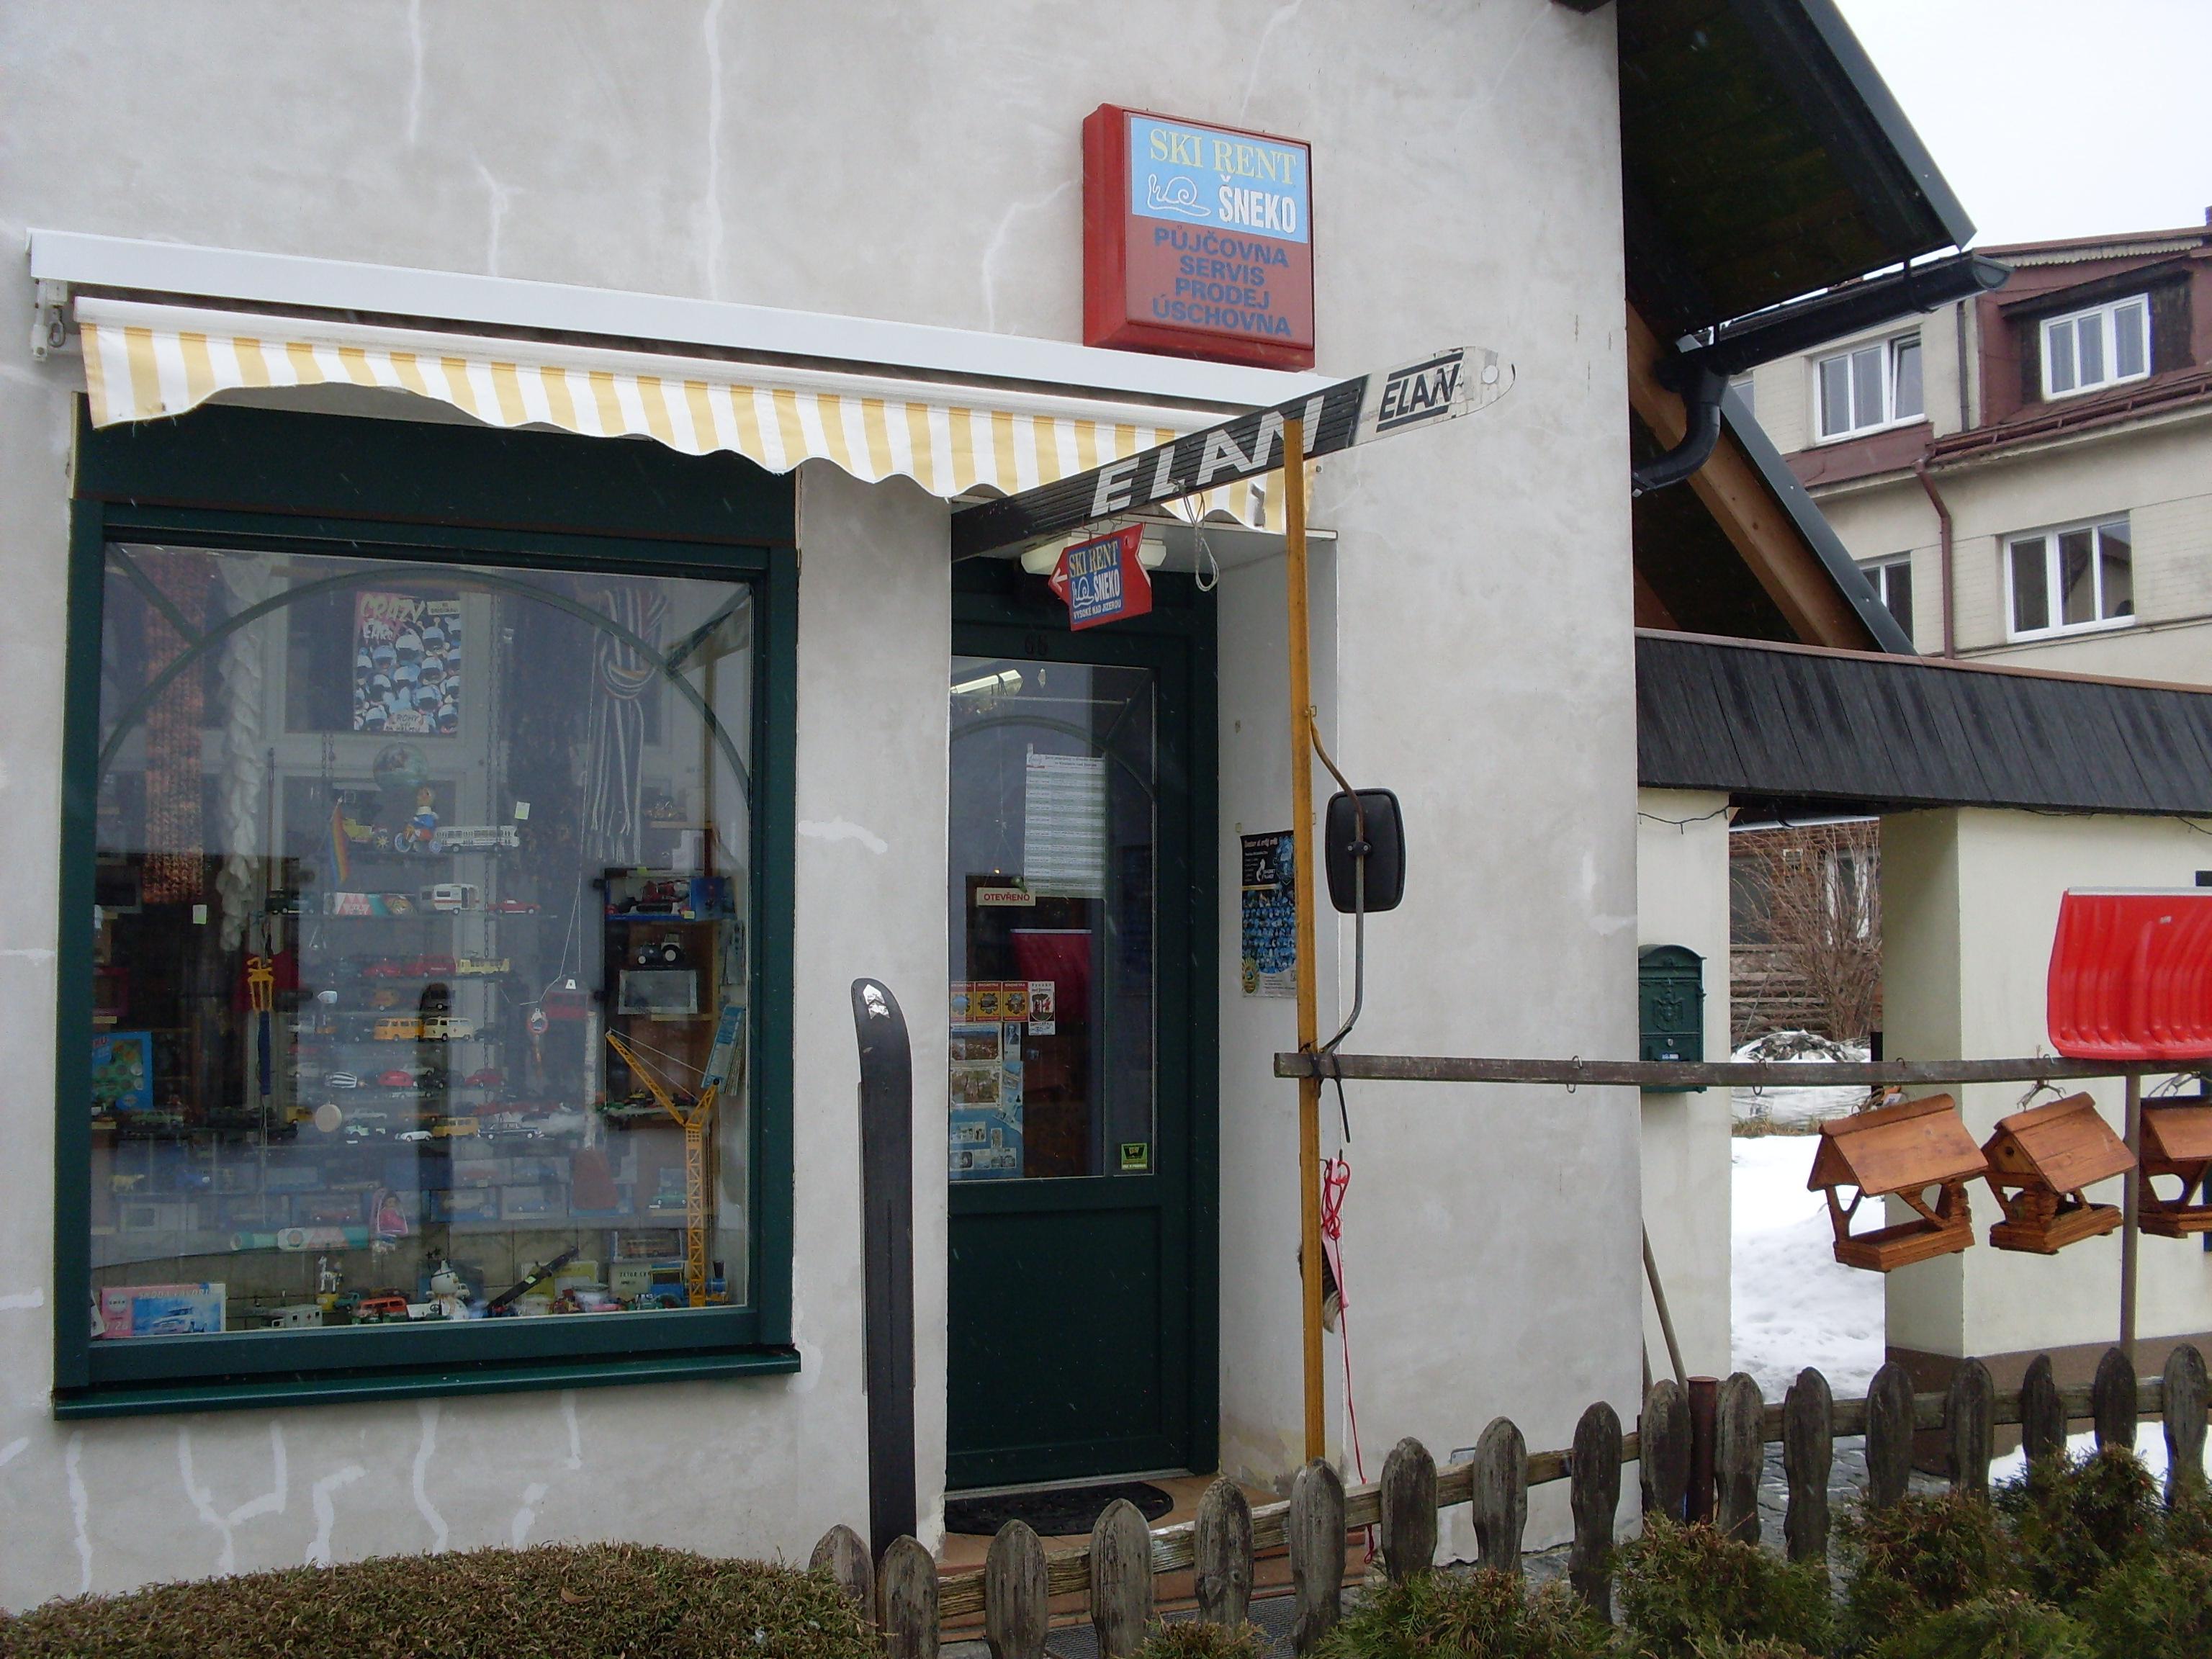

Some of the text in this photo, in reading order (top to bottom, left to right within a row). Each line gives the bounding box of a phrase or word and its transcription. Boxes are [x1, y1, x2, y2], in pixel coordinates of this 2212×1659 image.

[1150, 128, 1296, 184] SKI RENT
[1218, 174, 1296, 233] ŠNEKO
[1154, 224, 1290, 268] PŮJČOVNA
[1179, 255, 1265, 287] SERVIS
[1175, 277, 1271, 310] PRODEJ
[1152, 294, 1291, 337] ÚSCHOVNA
[1378, 363, 1461, 422] ELAN
[1090, 395, 1325, 517] ELAN
[1069, 541, 1118, 577] SKI RENT
[1093, 568, 1120, 603] ŠNEKO
[1073, 606, 1092, 620] VYSOKÉ
[1092, 603, 1102, 615] NAD
[984, 891, 1030, 901] OTEVŘENO
